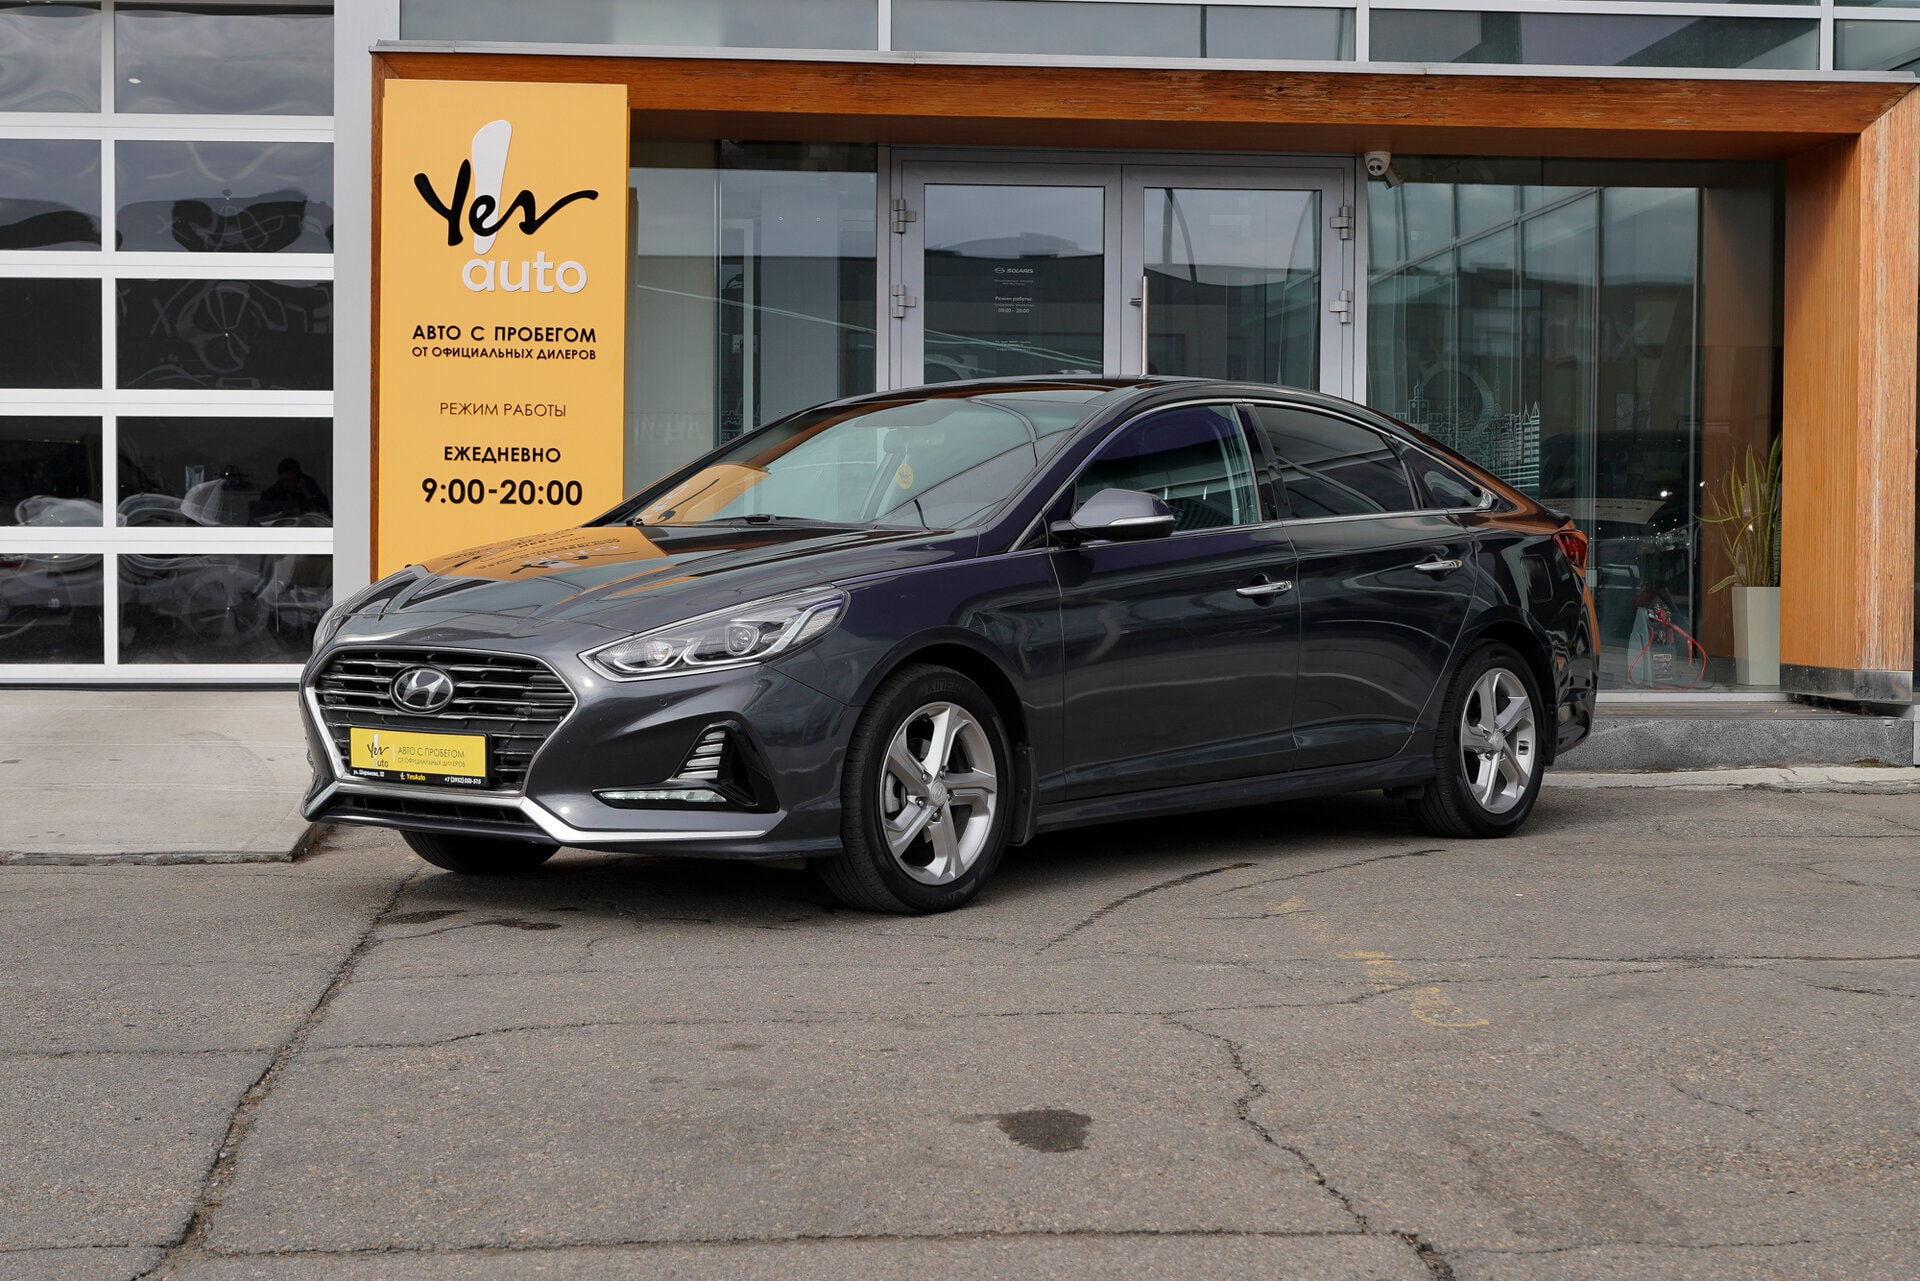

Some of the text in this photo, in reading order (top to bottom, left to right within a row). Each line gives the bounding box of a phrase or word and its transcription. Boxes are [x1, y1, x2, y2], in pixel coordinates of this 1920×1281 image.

[414, 159, 599, 246] Yes
[462, 251, 588, 293] auto
[412, 325, 597, 343] АВТО С ПРОБЕГОМ
[412, 347, 596, 360] ОТ ОФИЦИАЛЬНЫХ ДИЛЕРОВ
[440, 402, 567, 417] РЕЖИМ РАБОТЫ
[444, 446, 561, 463] ЕЖЕДНЕВНО
[421, 478, 583, 505] 9:00-20:00
[398, 746, 465, 759] АВТО С ПРОБЕГОМ
